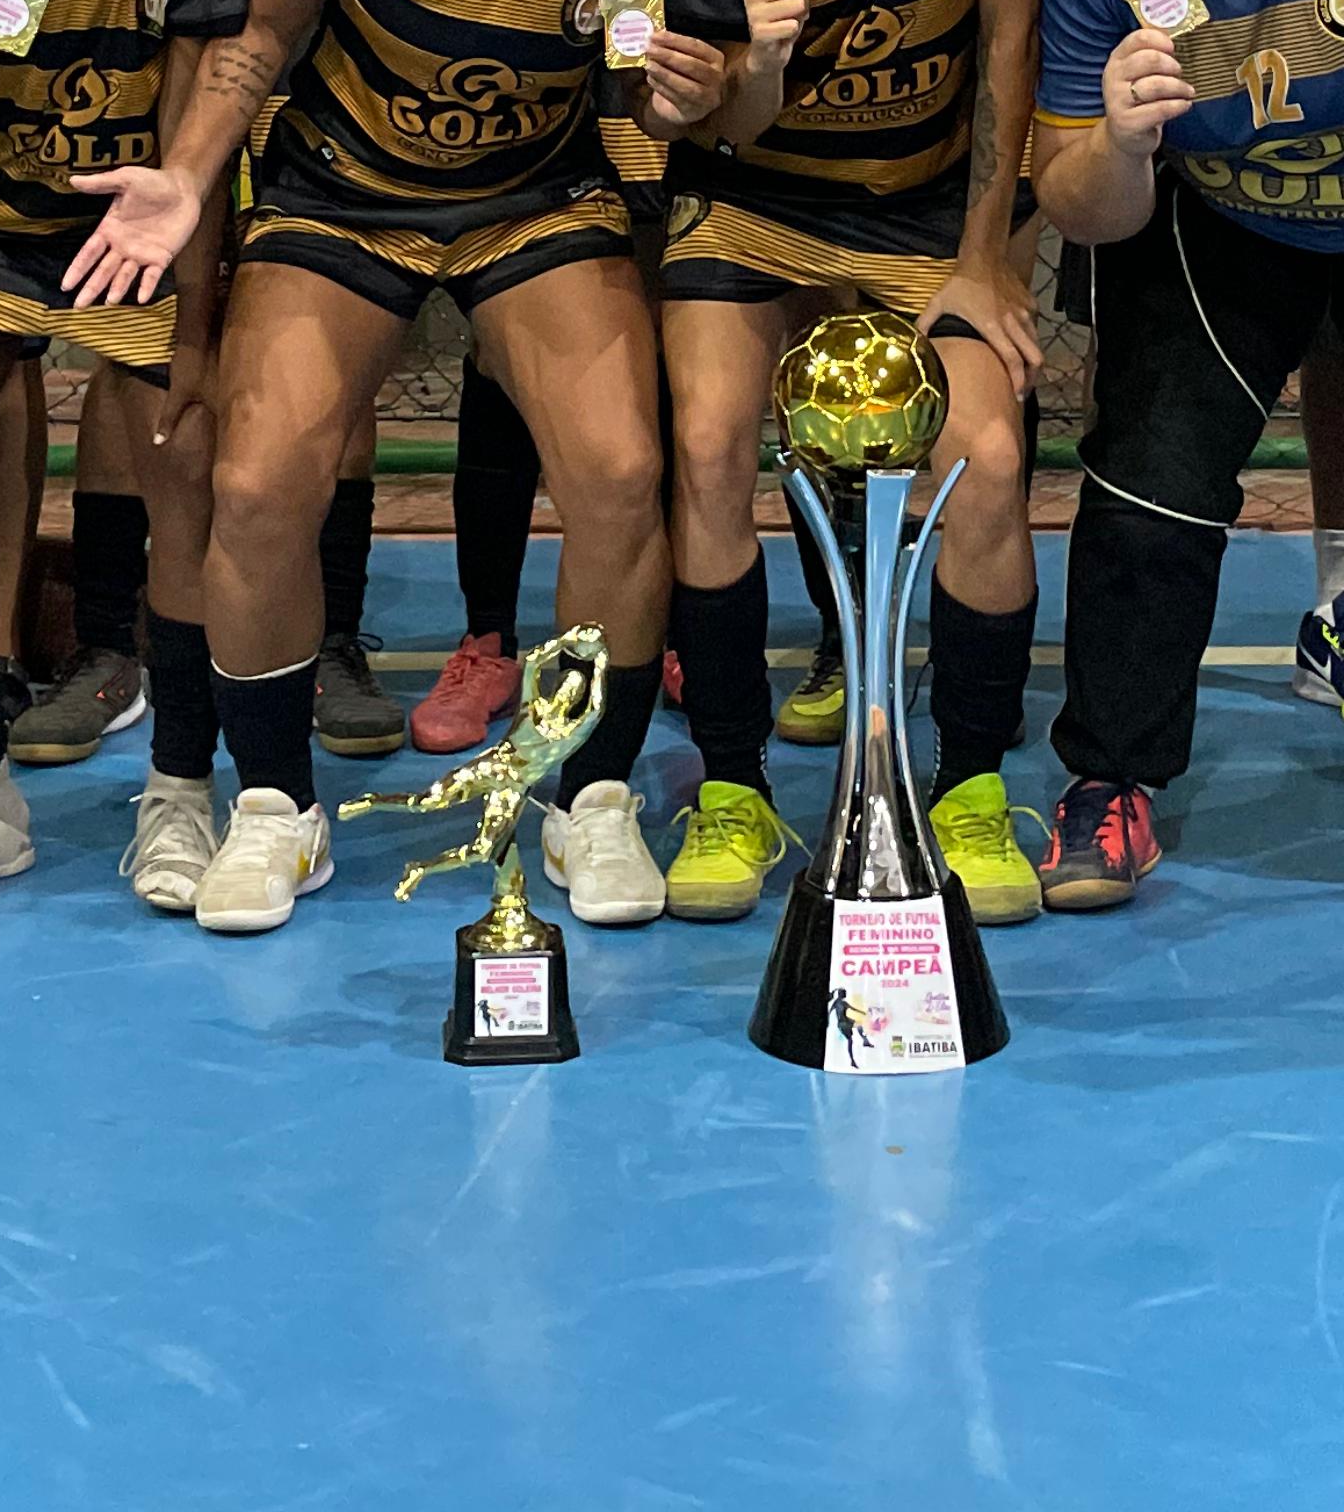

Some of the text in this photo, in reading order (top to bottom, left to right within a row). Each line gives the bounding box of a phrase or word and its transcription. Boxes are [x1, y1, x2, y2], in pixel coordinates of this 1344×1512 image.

[798, 52, 950, 107] OLD
[1235, 48, 1305, 130] 12
[390, 95, 549, 146] GOLD
[848, 928, 935, 941] FEMININO
[841, 954, 943, 977] CAMPEÃ
[908, 1040, 958, 1054] IBATIBA
